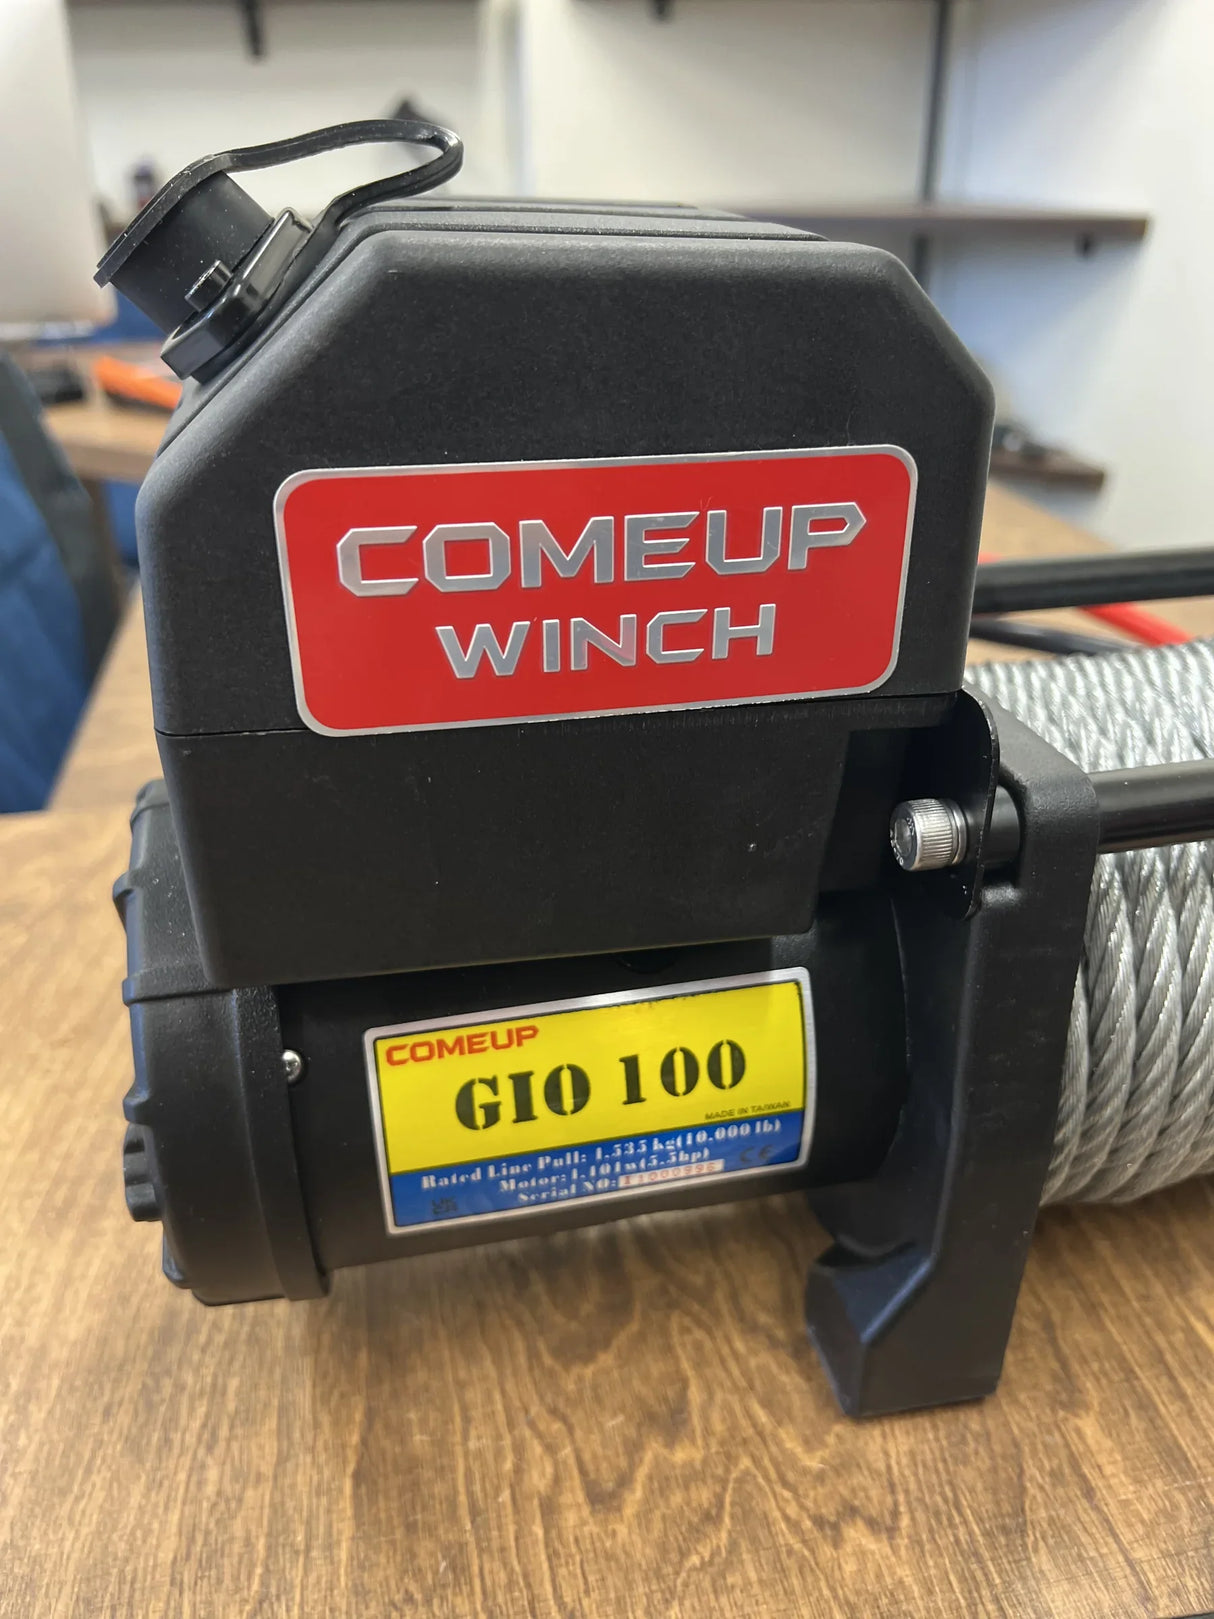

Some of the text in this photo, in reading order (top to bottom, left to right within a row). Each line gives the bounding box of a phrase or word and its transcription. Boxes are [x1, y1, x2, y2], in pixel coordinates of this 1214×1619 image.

[337, 502, 867, 597] COMEUP
[436, 604, 776, 678] WINCH
[385, 1025, 539, 1067] COMEUP
[455, 1039, 746, 1131] GIO 100
[705, 1101, 791, 1120] MADE IN TAIWAN
[421, 1167, 482, 1189] Rated
[487, 1162, 532, 1179] Line
[537, 1150, 587, 1170] Pull:
[500, 1174, 567, 1192] Motor:
[518, 1183, 577, 1202] Serial
